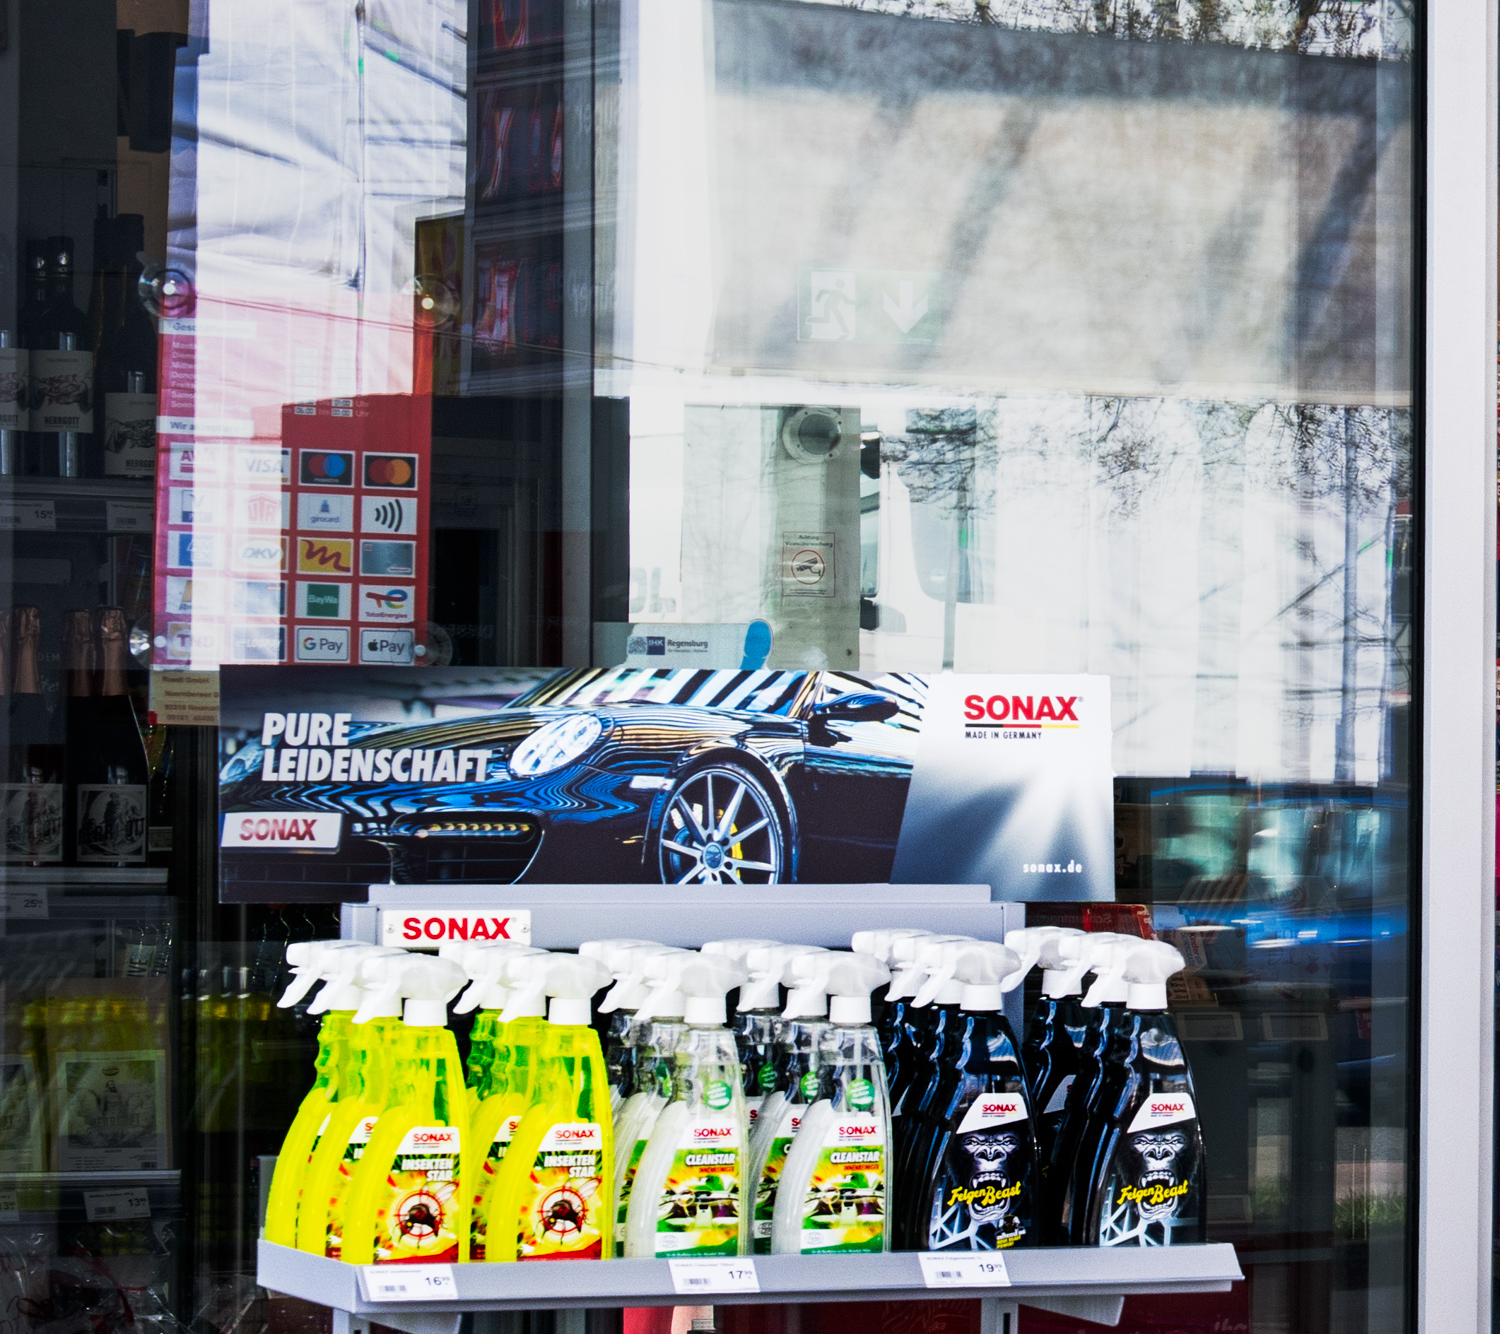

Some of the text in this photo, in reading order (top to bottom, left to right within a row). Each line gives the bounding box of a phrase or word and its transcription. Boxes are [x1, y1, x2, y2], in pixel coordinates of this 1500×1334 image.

[310, 515, 339, 524] girocard
[308, 595, 338, 605] BayWa
[319, 638, 343, 654] Pay
[379, 640, 405, 654] Pay
[648, 638, 708, 649] IHK Regensburg
[964, 694, 1080, 722] SONAX
[261, 712, 353, 748] PURE
[965, 731, 1042, 740] MADE IN GERMANY
[261, 747, 493, 783] LEIDENSCHAFT
[238, 819, 317, 842] SONAX
[1022, 859, 1083, 874] sonax.de
[402, 917, 511, 941] SONAX
[401, 1158, 454, 1171] INSEKTEN
[685, 1153, 736, 1166] CLEANSTAR
[427, 1169, 453, 1182] STAR
